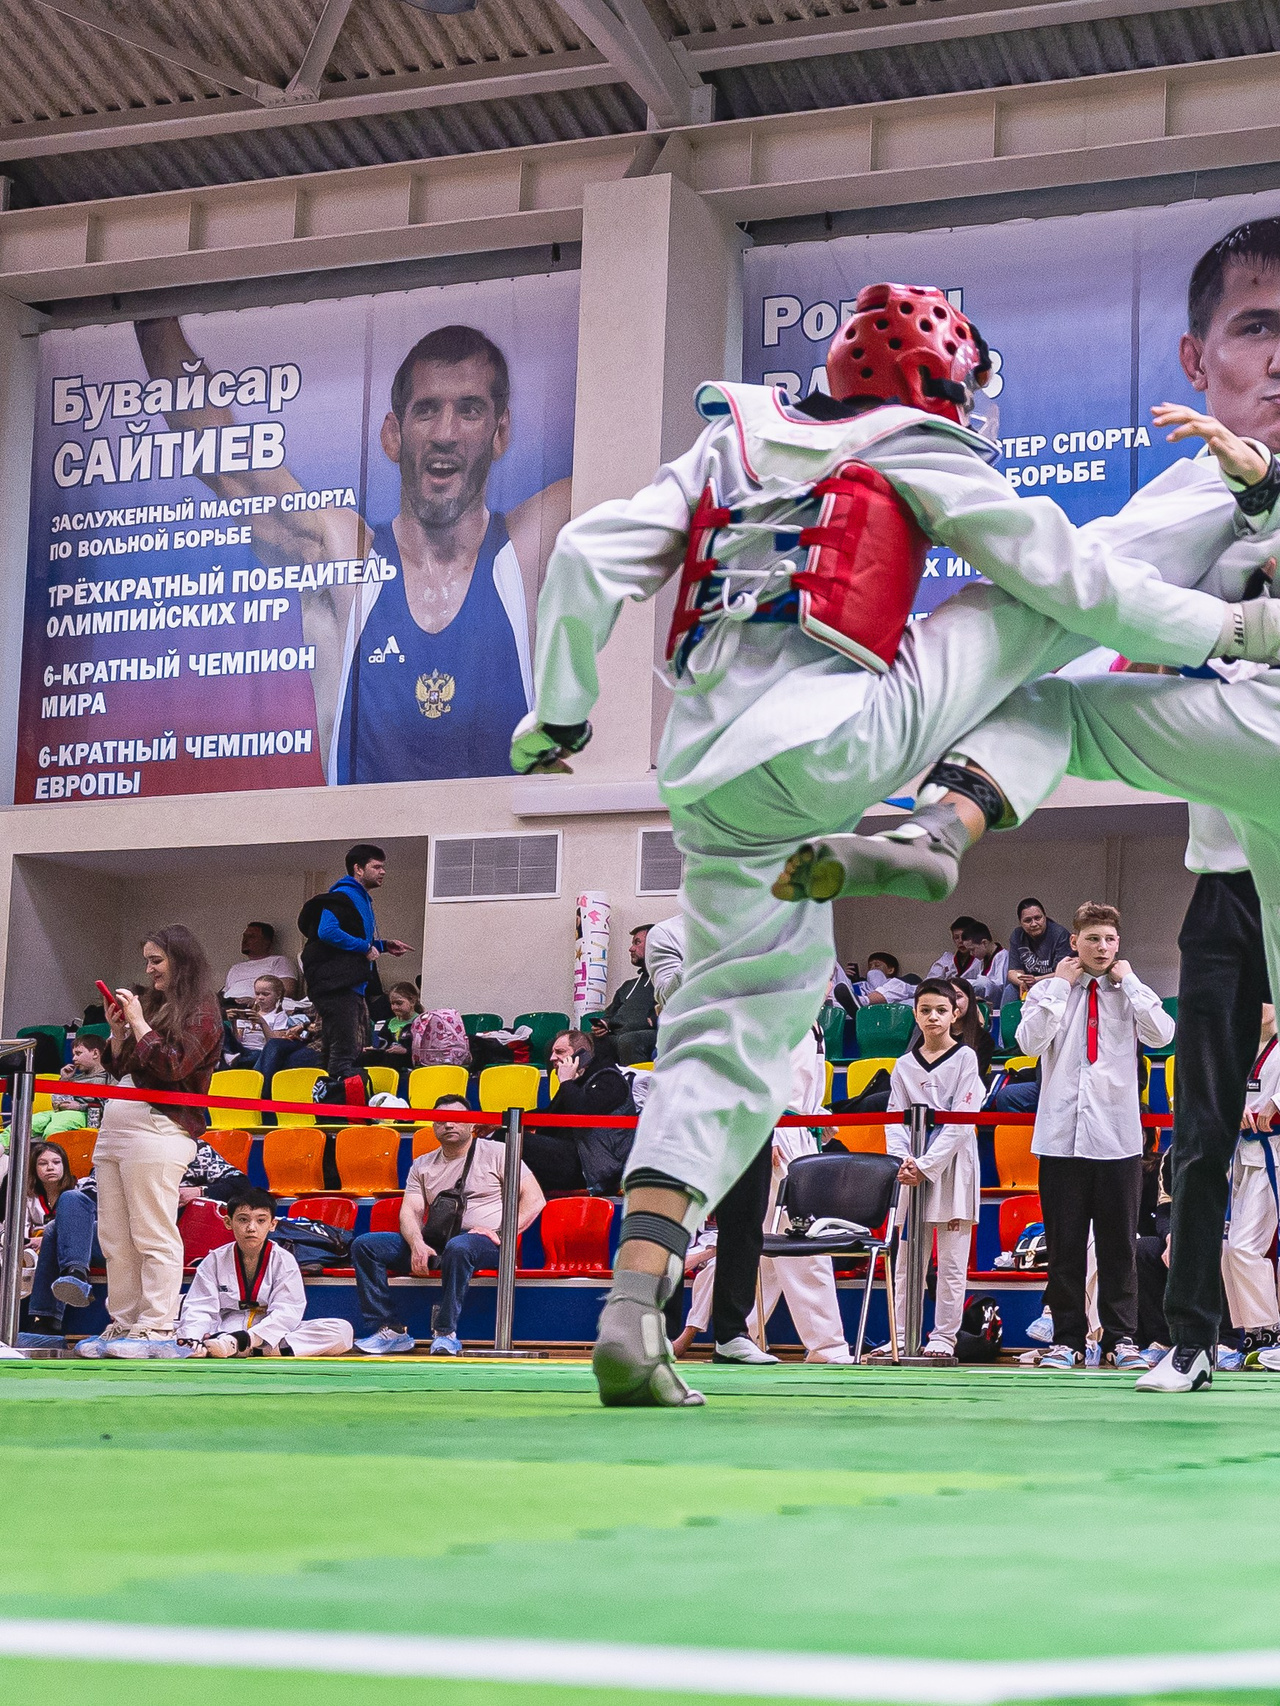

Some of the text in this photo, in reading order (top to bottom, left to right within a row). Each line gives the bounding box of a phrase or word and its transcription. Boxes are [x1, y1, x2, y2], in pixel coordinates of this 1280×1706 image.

[52, 358, 301, 431] Бувайсар
[53, 422, 285, 487] САЙТИЕВ
[1053, 427, 1151, 454] СПОРТА
[1006, 460, 1106, 488] БОРЬБЕ
[51, 489, 356, 533] ЗАСЛУЖЕННЫЙ МАСТЕР СПОРТА
[50, 527, 252, 560] ПО ВОЛЬНОЙ БОРЬБЕ
[49, 559, 397, 607] ТРЁХКРАТНЫЙ ПОБЕДИТЕЛЬ
[46, 600, 289, 638] ОЛИМПИЙСКИХ ИГР
[43, 647, 315, 686] 6-КРАТНЫЙ ЧЕМПИОН
[41, 691, 106, 719] МИРА
[38, 730, 312, 768] 6-КРАТНЫЙ ЧЕМПИОН
[36, 772, 140, 799] ЕВРОПЫ
